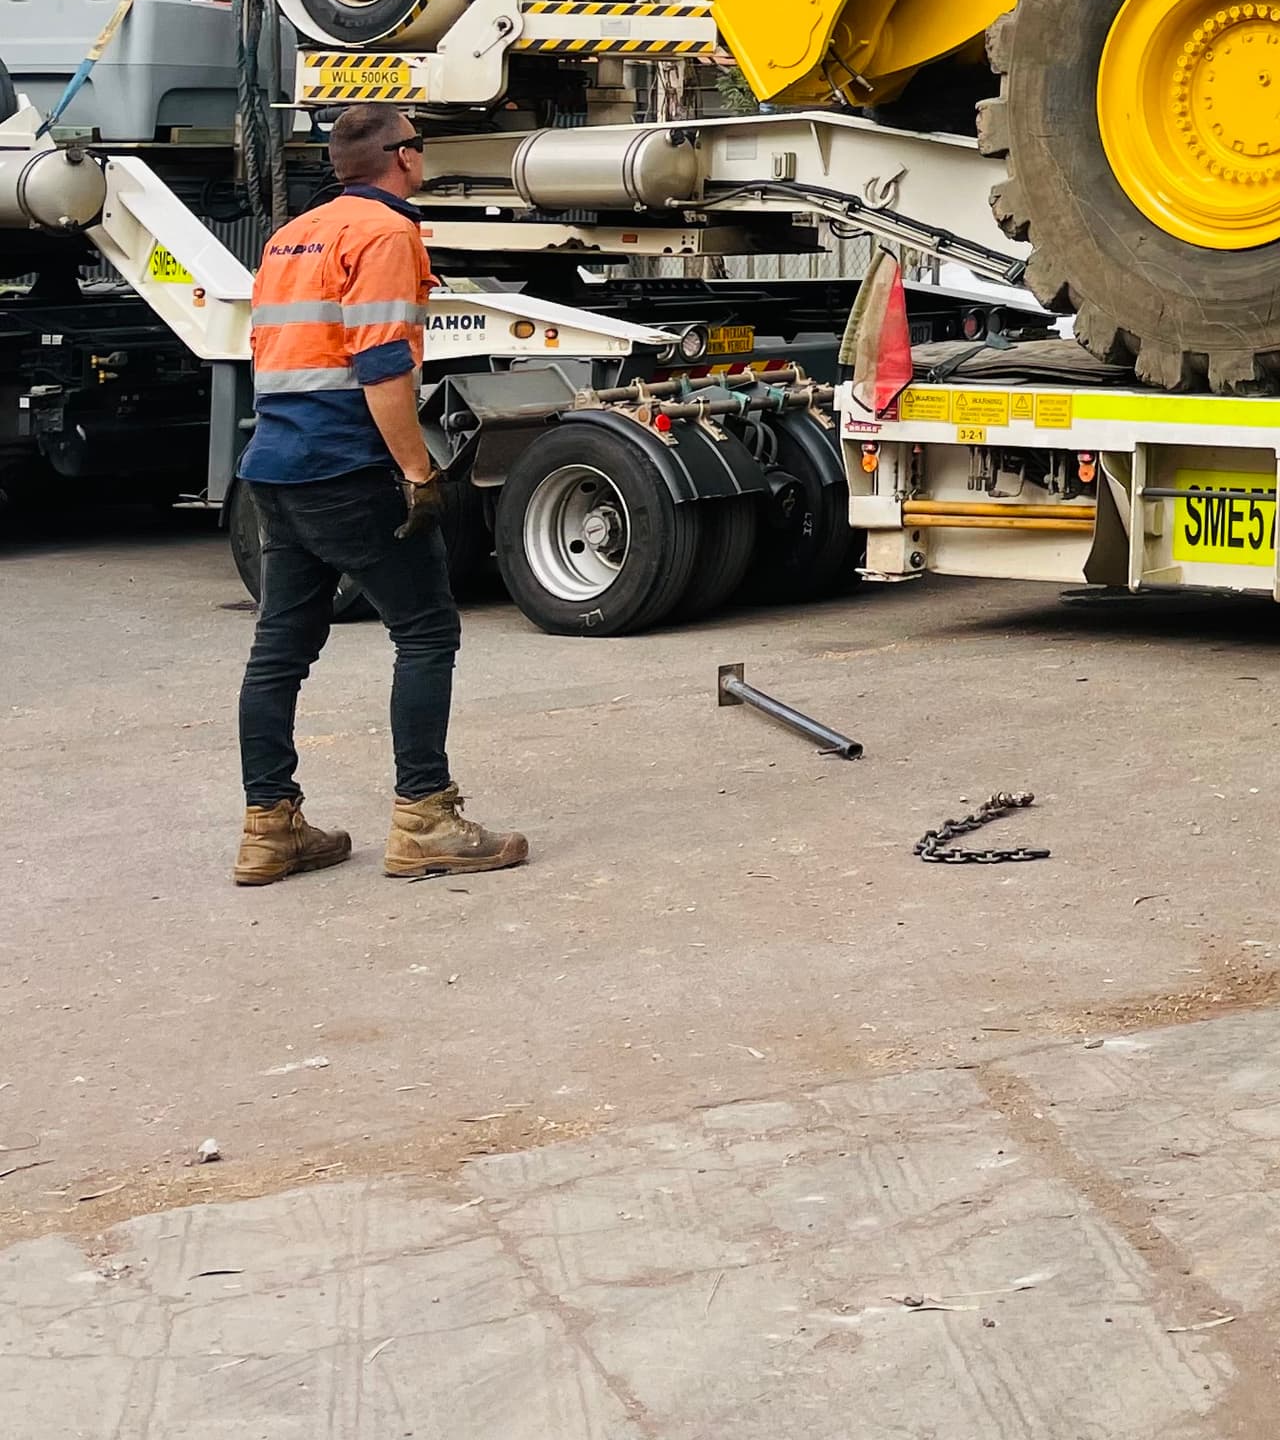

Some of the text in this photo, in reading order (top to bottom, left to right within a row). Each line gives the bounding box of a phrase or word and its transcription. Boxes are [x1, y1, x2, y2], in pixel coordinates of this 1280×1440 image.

[332, 72, 399, 84] WLL 500KG
[960, 430, 983, 440] 3-2-1
